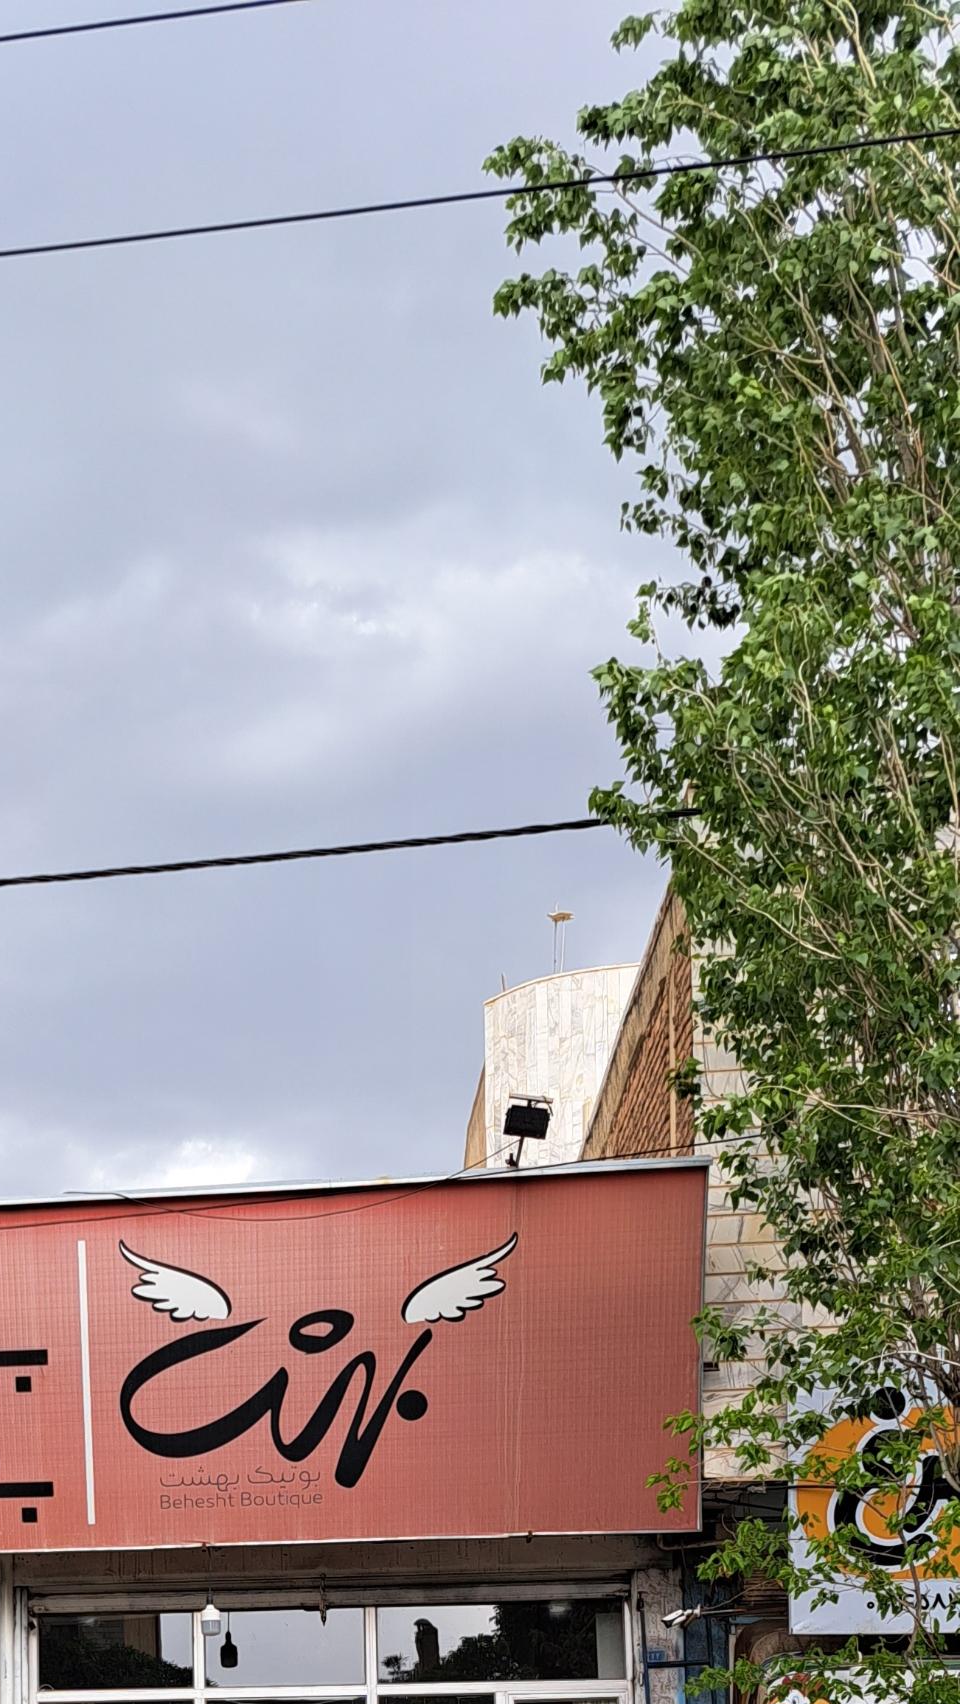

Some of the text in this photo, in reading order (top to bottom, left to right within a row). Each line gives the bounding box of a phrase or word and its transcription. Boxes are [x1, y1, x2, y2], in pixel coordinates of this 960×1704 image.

[159, 1465, 322, 1492] بوتیک بهشت
[159, 1491, 323, 1510] Behesht Boutique
